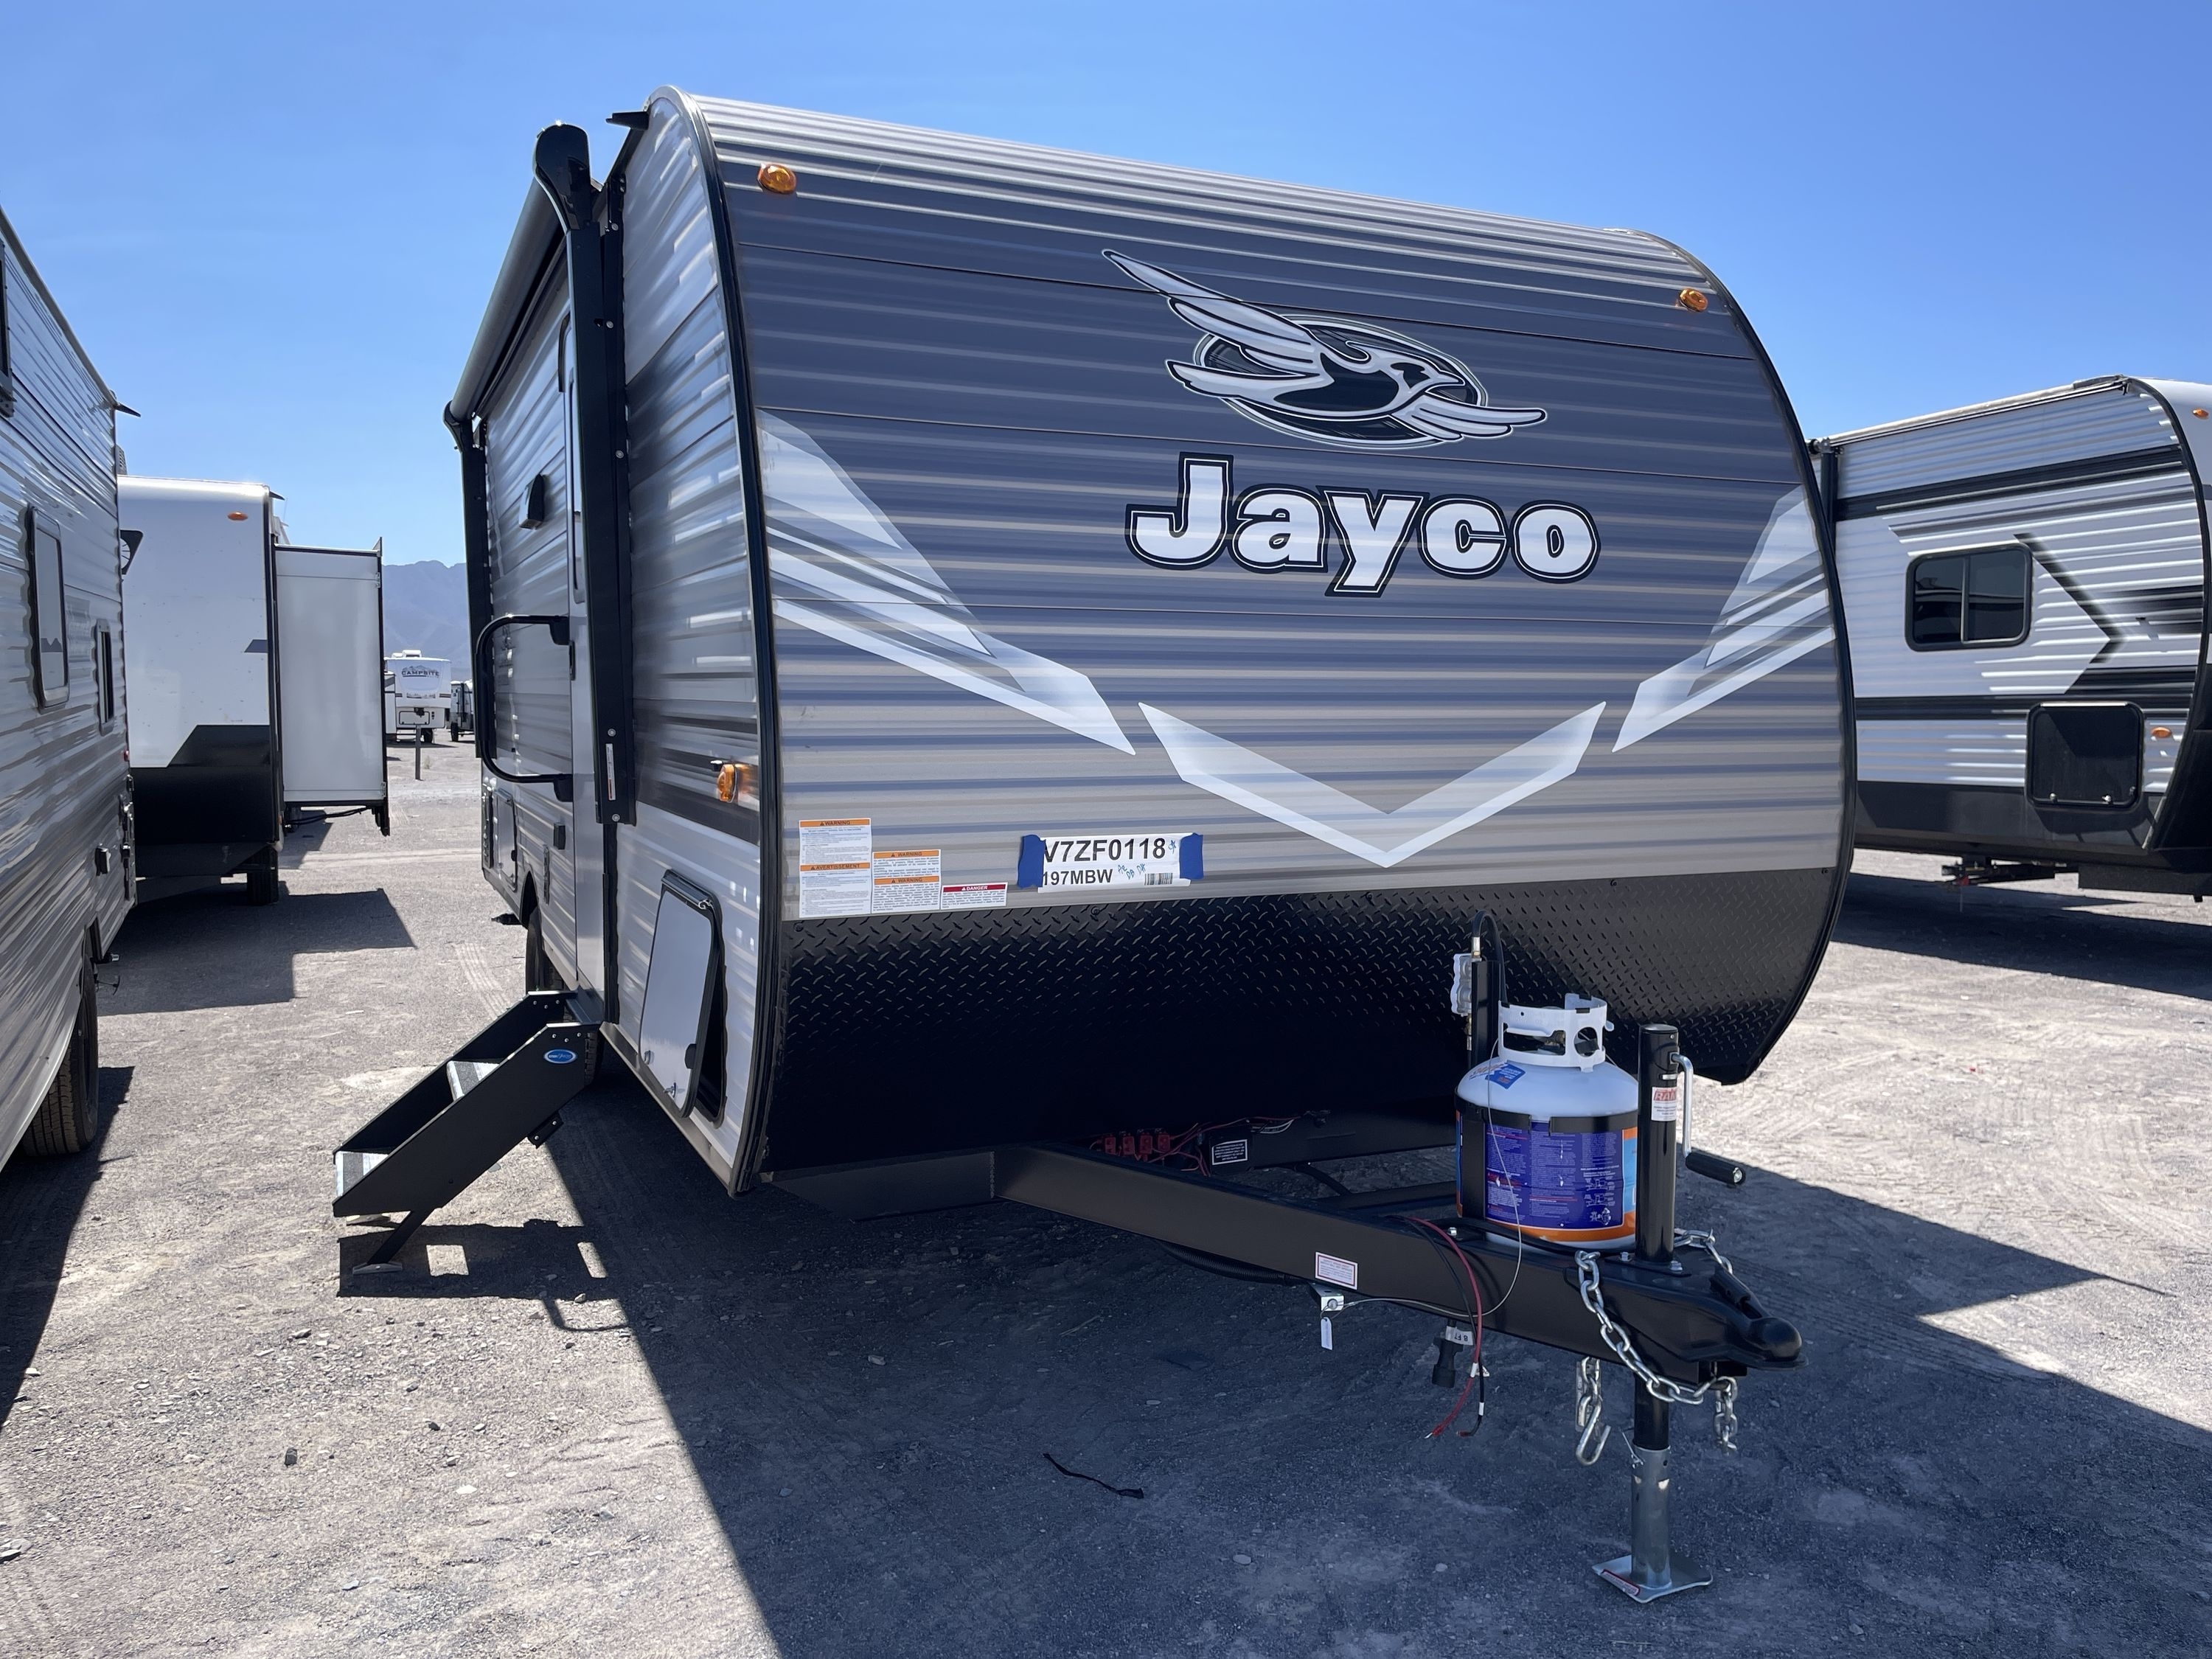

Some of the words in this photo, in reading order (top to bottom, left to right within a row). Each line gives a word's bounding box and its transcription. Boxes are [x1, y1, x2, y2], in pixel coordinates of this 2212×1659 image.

[1125, 452, 1601, 597] Jayco
[1045, 838, 1166, 863] V7ZF0118
[1043, 869, 1113, 886] 197MBW
